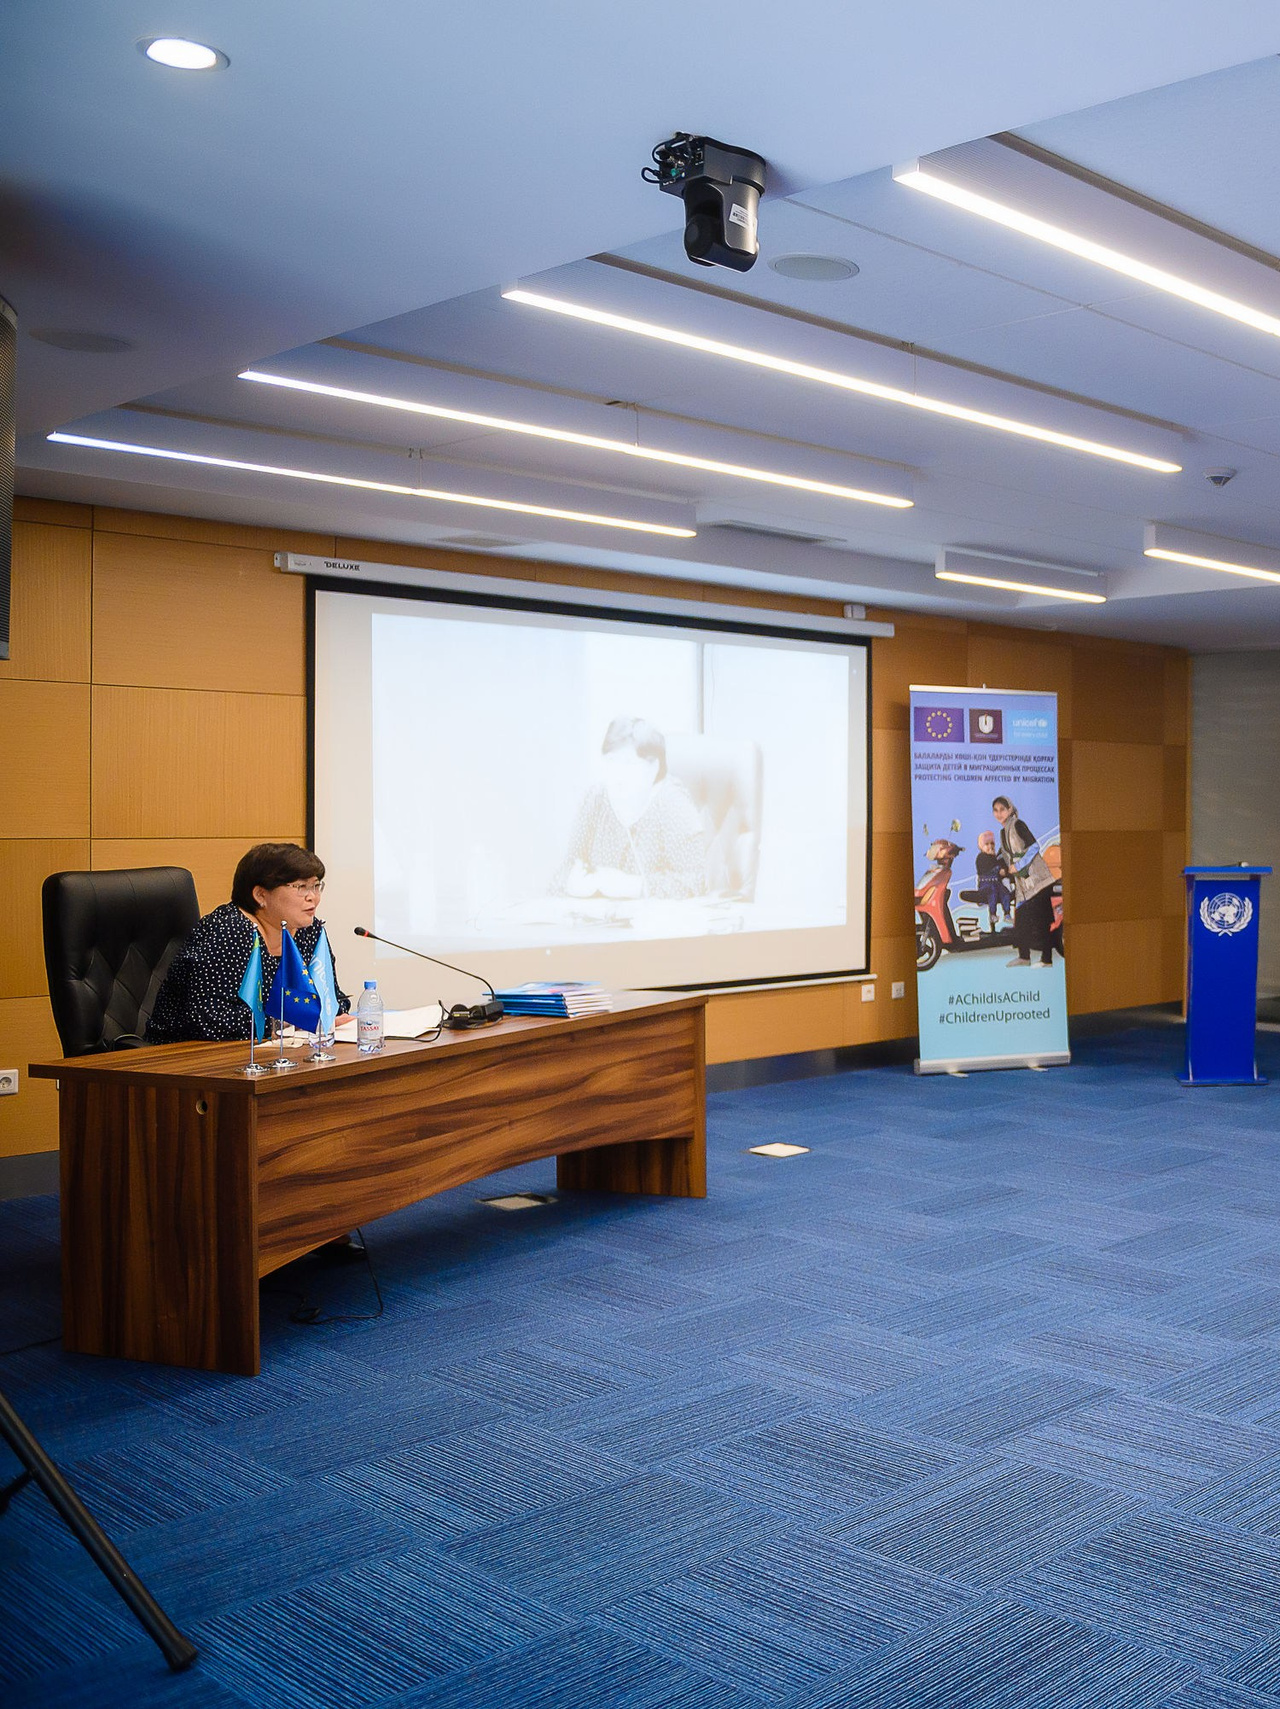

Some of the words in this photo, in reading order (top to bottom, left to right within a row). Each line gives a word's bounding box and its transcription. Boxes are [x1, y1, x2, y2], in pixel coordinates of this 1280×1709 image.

[324, 560, 361, 571] DELUXE
[1012, 718, 1037, 728] unicef
[915, 763, 941, 771] ЗАЩИТА
[943, 763, 962, 771] ДЕТЕЙ
[969, 764, 1021, 773] МИГРАЦИОННЫХ
[1022, 766, 1055, 774] ПРОЦЕССАХ
[948, 990, 1040, 1006] #AChildIsAChild
[939, 1008, 1051, 1025] #ChildrenUprooted
